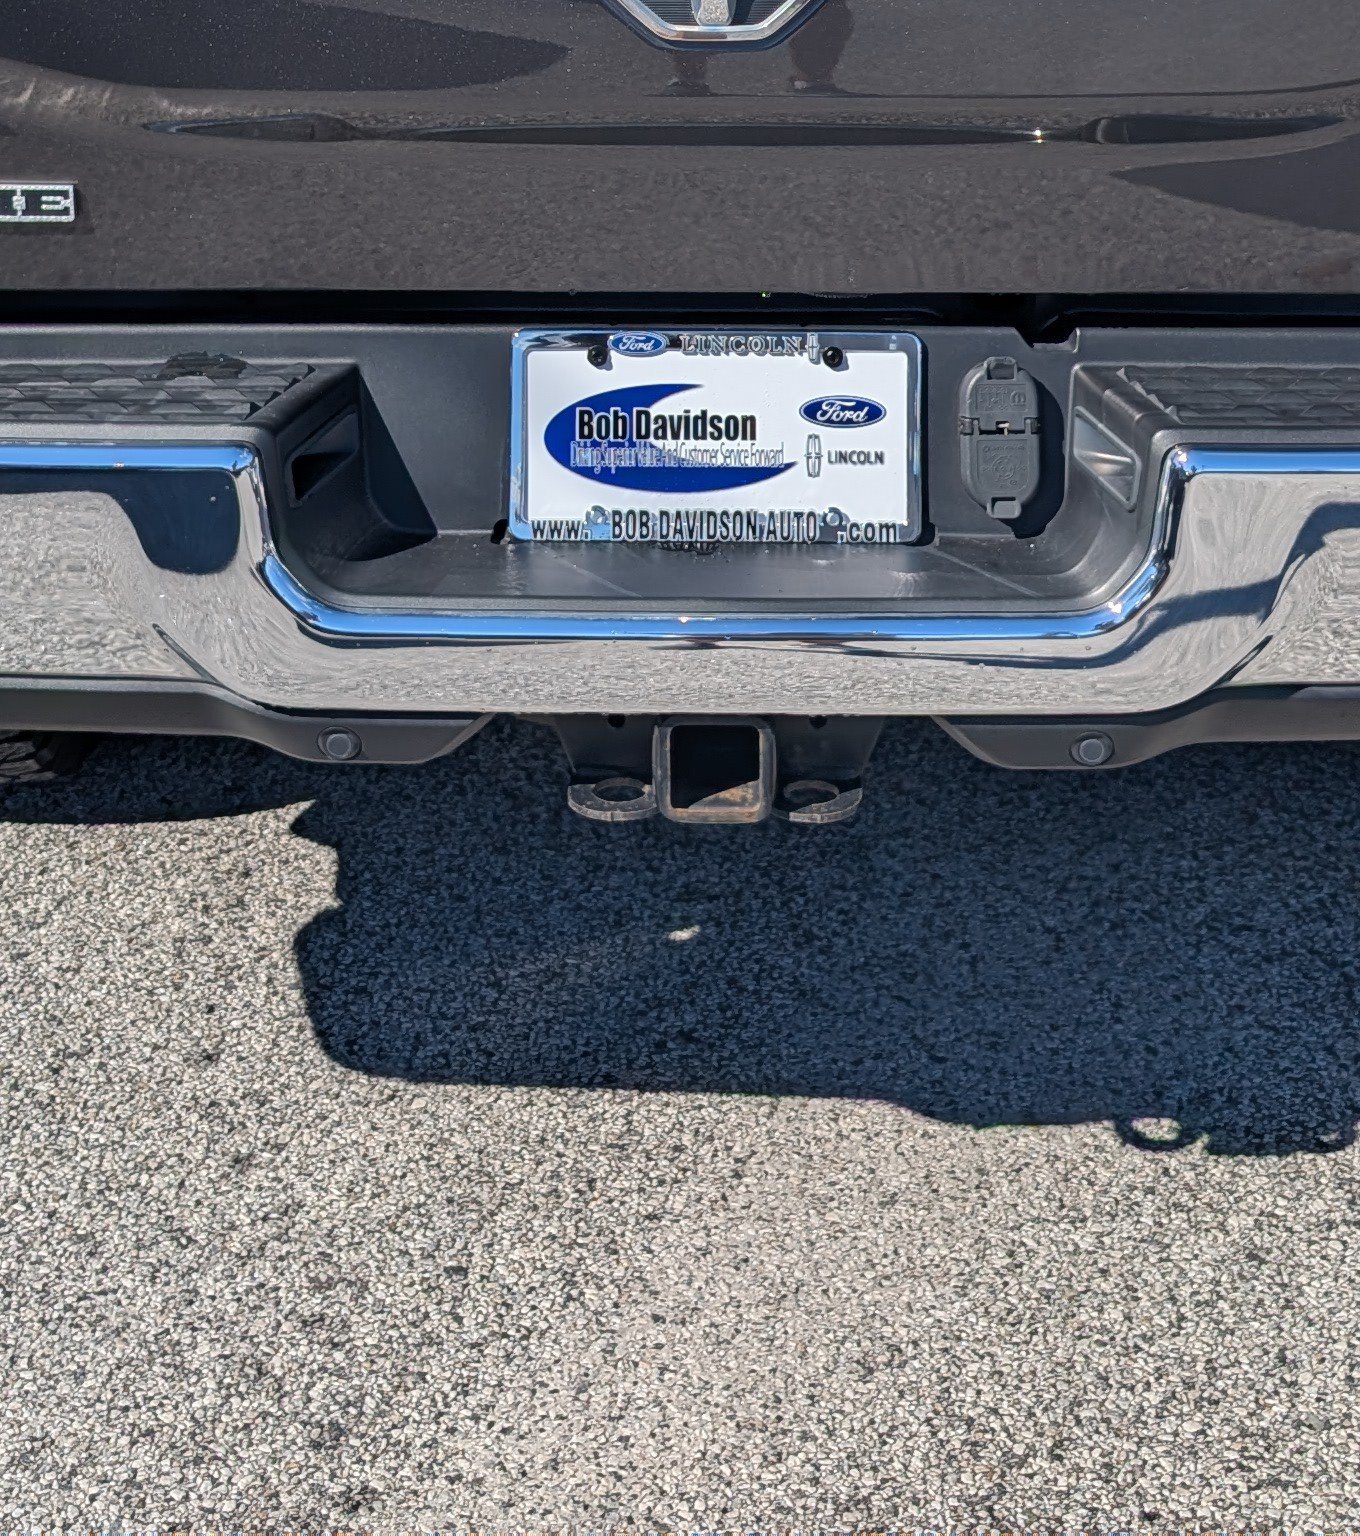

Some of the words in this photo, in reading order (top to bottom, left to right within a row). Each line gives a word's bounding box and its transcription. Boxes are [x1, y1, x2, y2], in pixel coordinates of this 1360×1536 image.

[619, 335, 655, 351] Ford
[679, 335, 803, 353] LINCOLN
[816, 400, 870, 422] Ford
[577, 409, 627, 441] Bob
[635, 409, 757, 441] Davidson
[679, 442, 718, 467] Customer
[720, 442, 749, 467] Service
[751, 441, 785, 467] Forward
[827, 450, 885, 465] LINCOLN
[611, 509, 651, 541] BOB
[659, 509, 758, 542] DAVIDSON
[766, 509, 818, 541] AUTO
